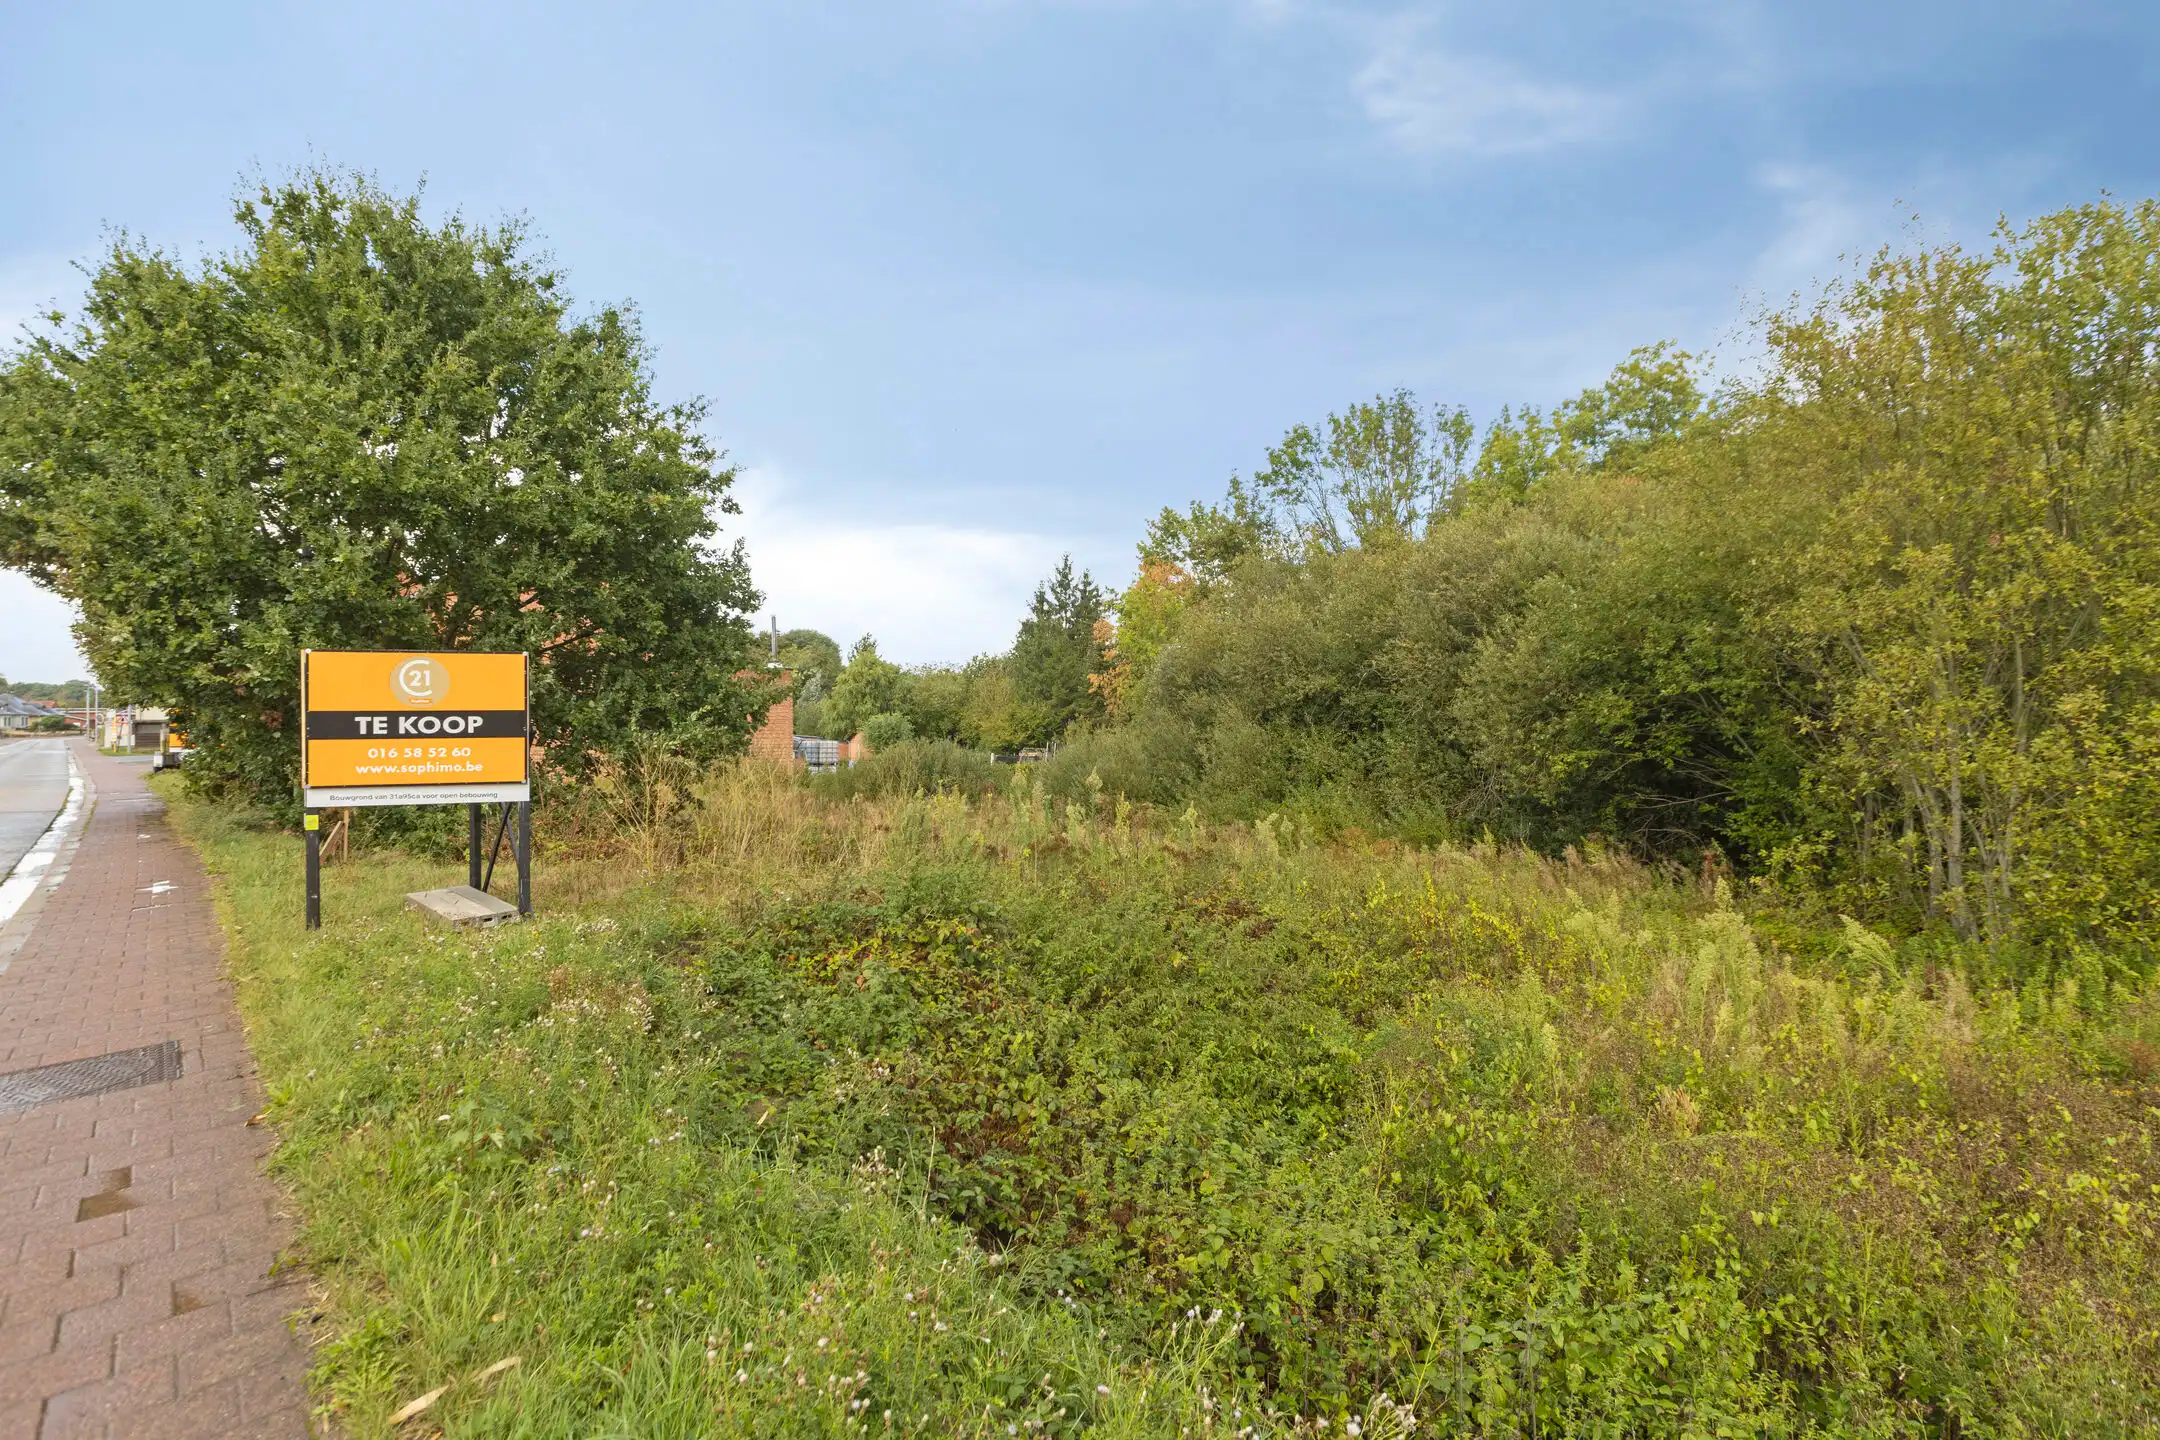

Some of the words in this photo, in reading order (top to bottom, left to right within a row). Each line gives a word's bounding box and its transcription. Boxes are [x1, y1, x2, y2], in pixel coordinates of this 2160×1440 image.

[408, 669, 431, 687] 21
[354, 716, 388, 735] TE
[398, 715, 484, 735] KOOP
[367, 747, 399, 759] 016
[403, 747, 423, 758] 58
[428, 747, 447, 758] 52
[451, 746, 472, 757] 60
[355, 760, 484, 775] www.sophimo.be
[329, 794, 373, 802] Bouwgrond
[440, 792, 458, 800] open
